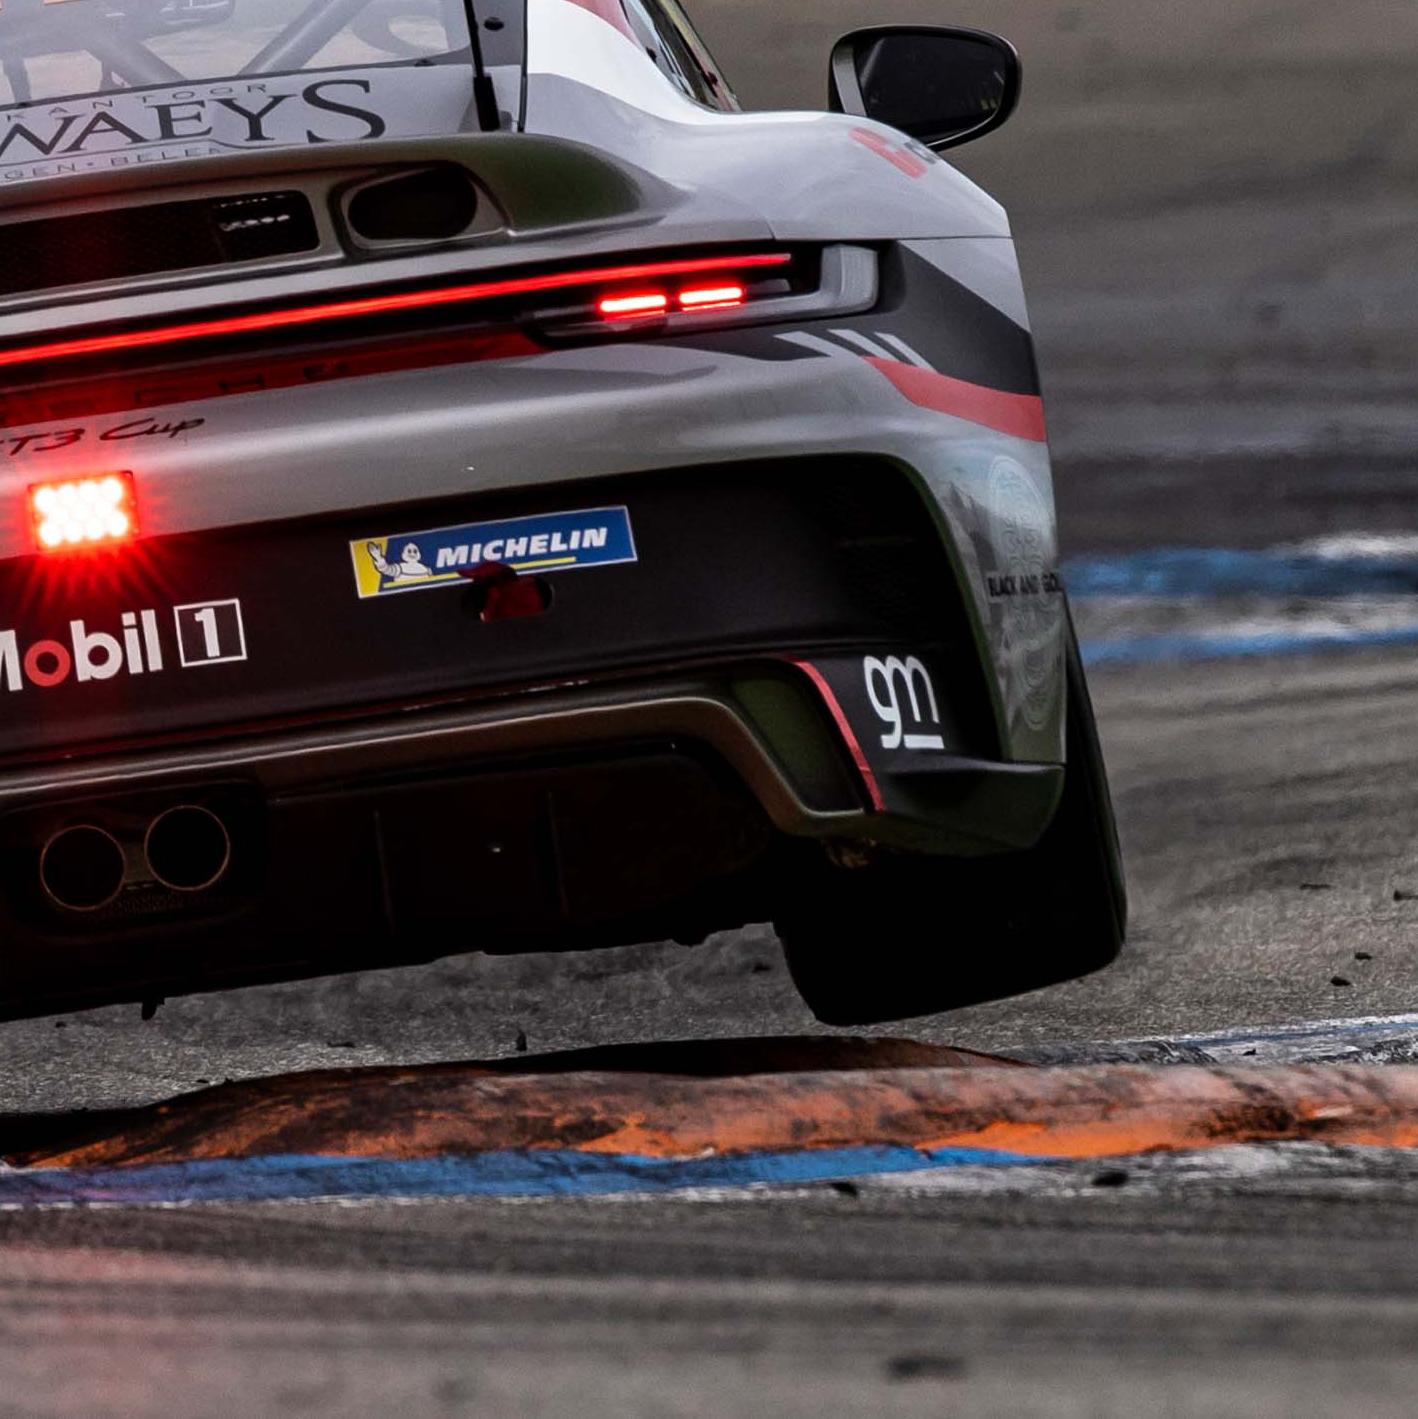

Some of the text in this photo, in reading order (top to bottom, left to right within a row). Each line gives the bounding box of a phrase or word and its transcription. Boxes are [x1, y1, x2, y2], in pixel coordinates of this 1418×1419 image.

[99, 416, 206, 442] Cup
[435, 526, 609, 569] MICHELIN
[193, 607, 221, 659] 1
